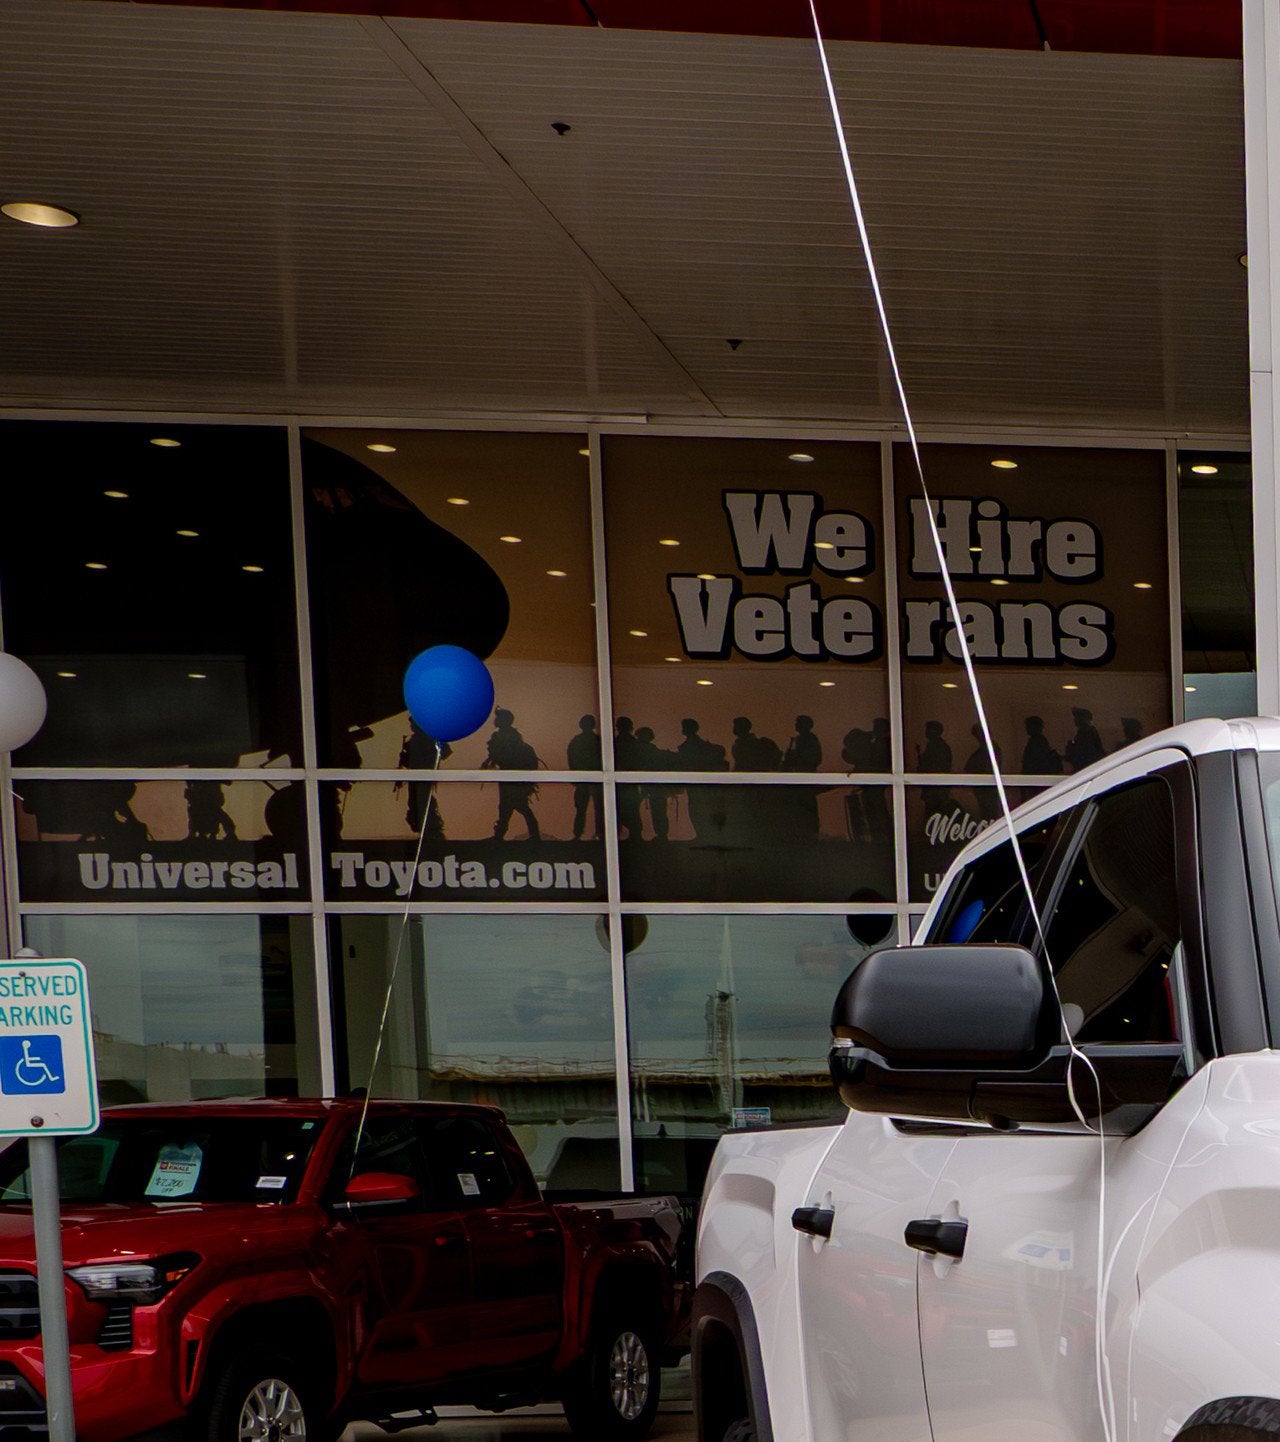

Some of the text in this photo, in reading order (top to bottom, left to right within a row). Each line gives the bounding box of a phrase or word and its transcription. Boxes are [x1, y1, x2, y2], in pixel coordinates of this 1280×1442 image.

[722, 490, 1103, 581] We Hire
[78, 851, 596, 896] Universal Toyota.com
